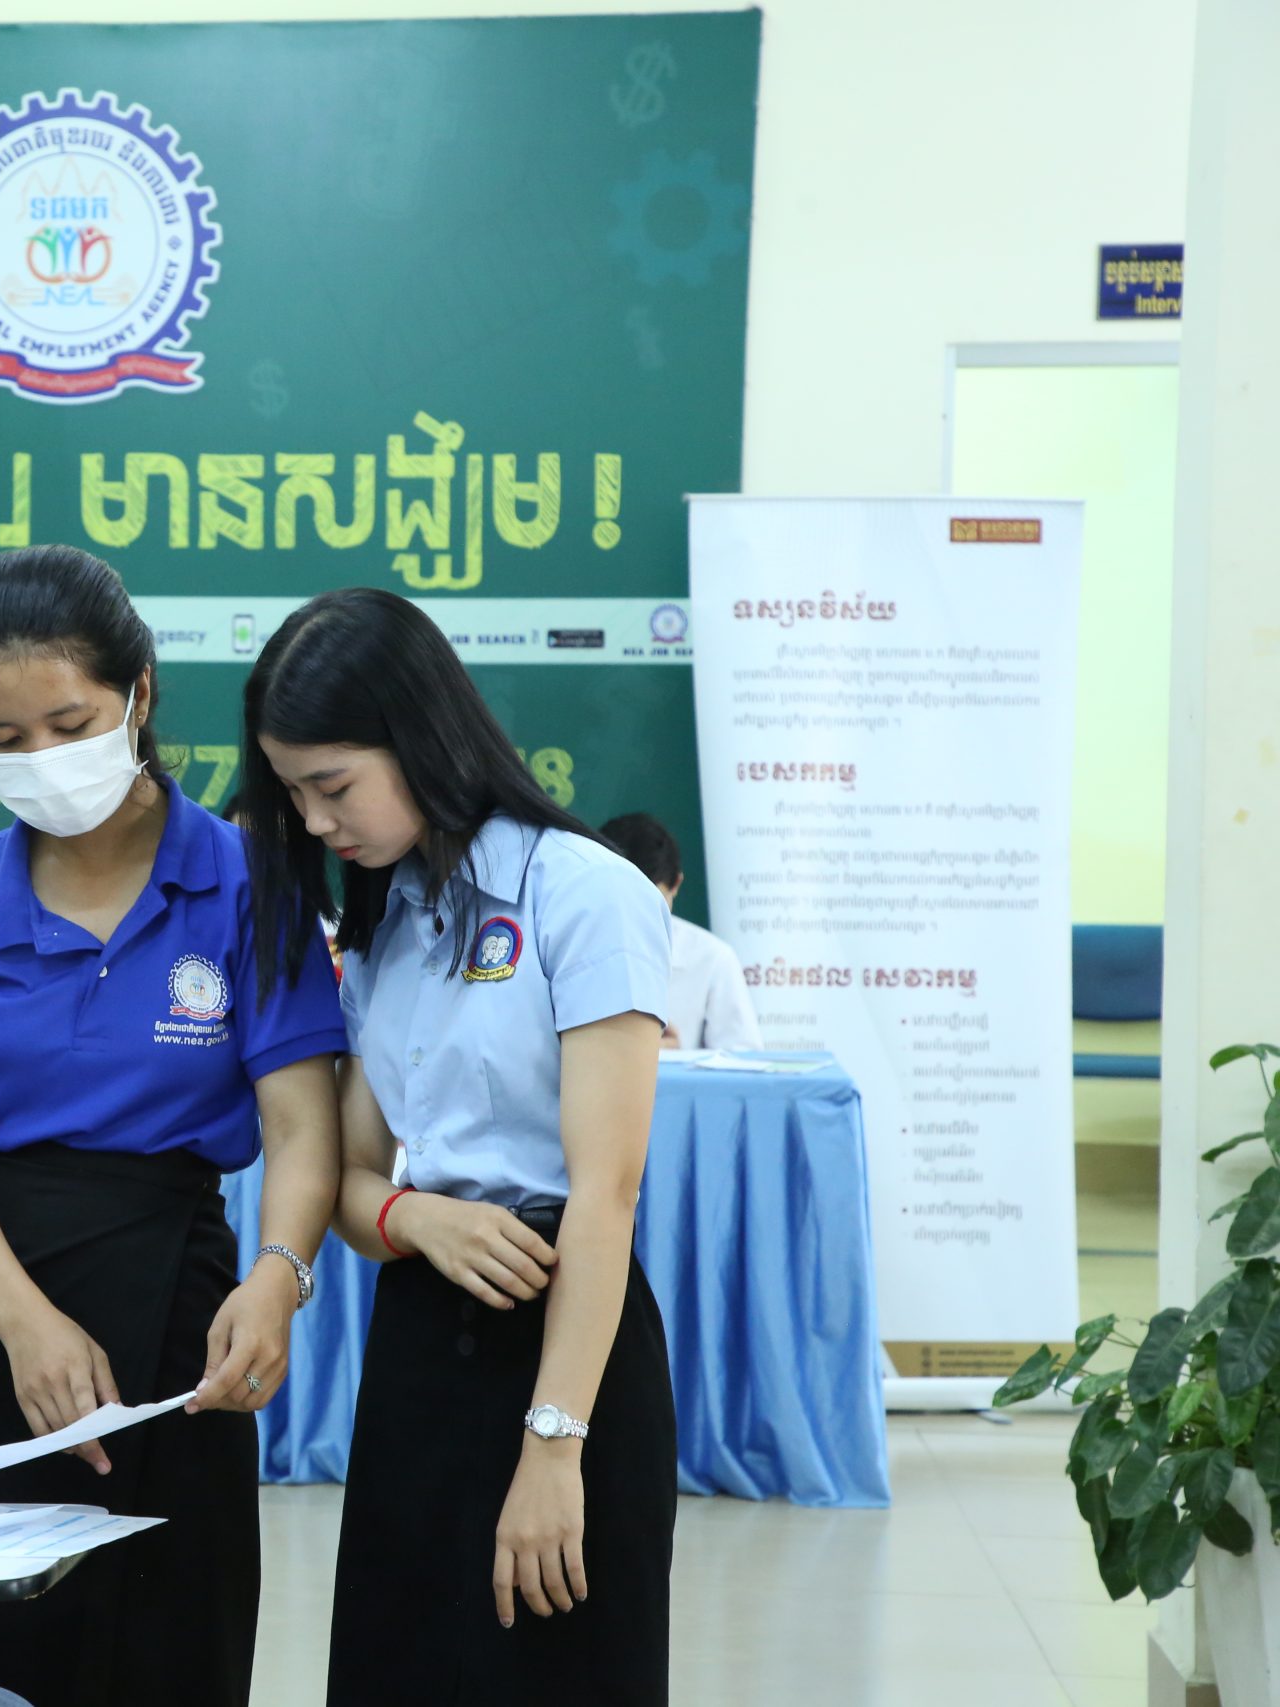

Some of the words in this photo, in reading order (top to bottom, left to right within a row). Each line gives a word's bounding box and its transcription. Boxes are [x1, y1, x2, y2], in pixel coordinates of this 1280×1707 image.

[19, 324, 137, 358] EMPLOYMENT
[142, 259, 181, 324] AGENCY
[592, 453, 622, 551] !
[149, 625, 207, 646] gency
[516, 747, 575, 809] 8
